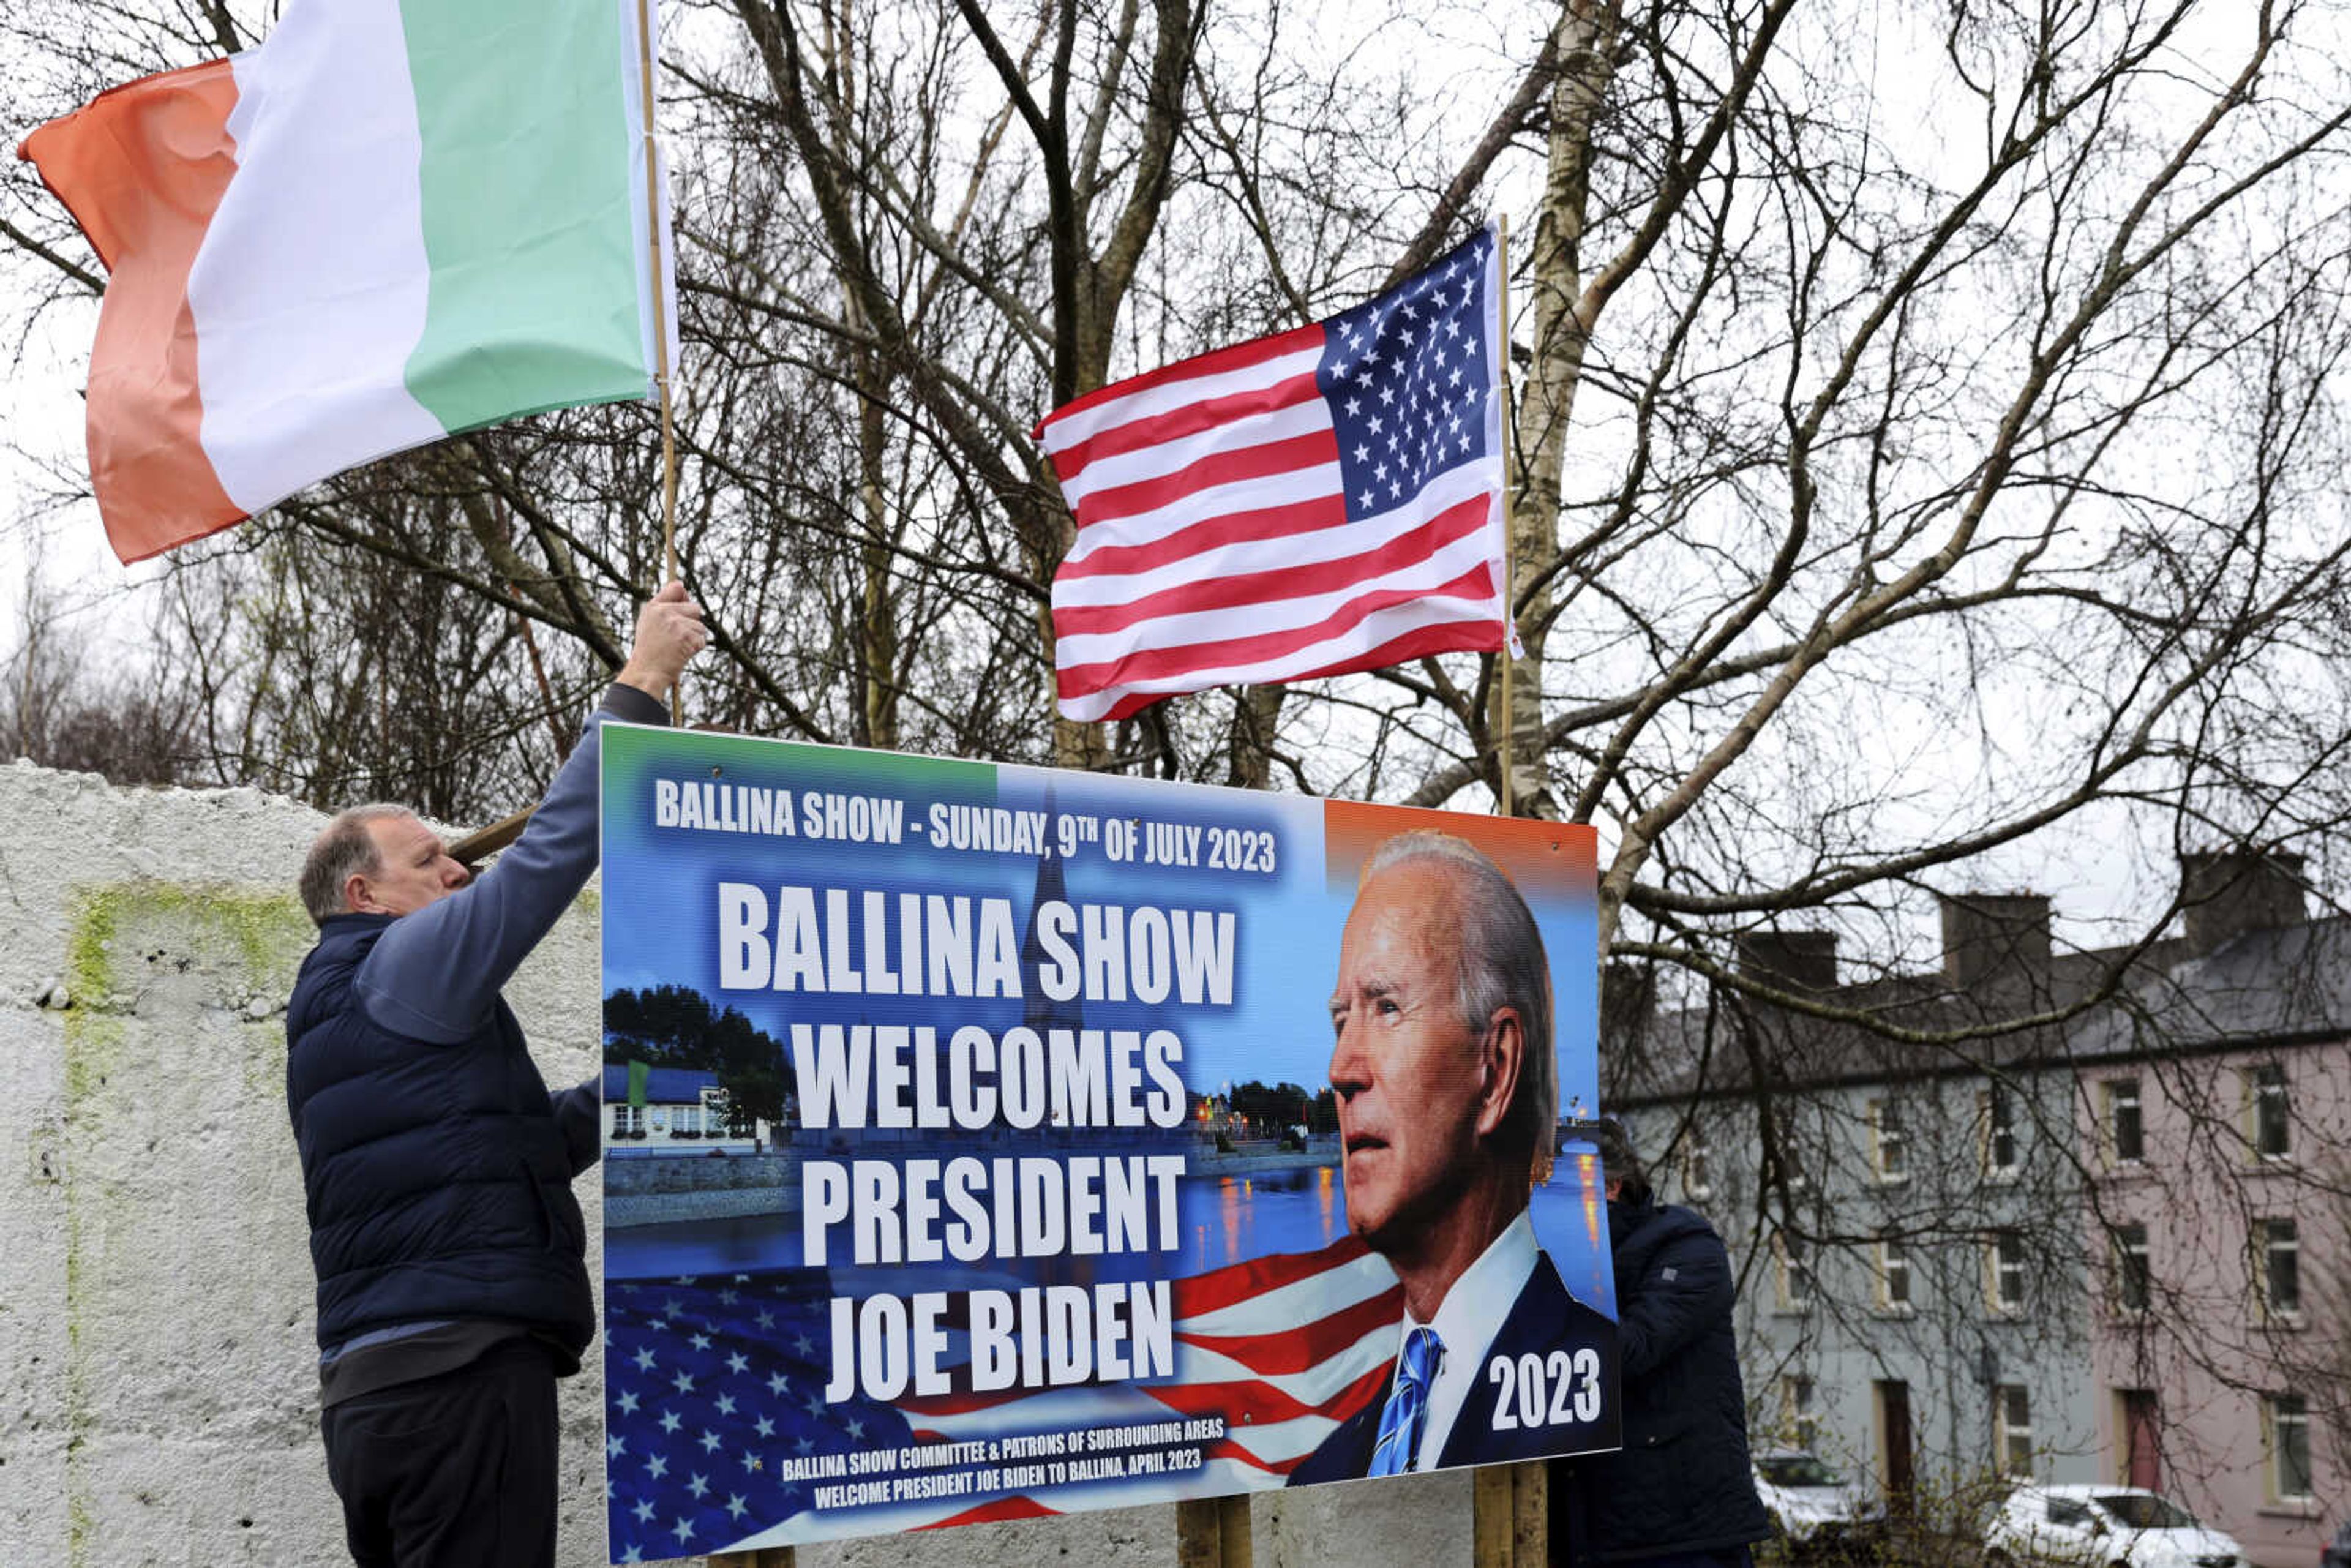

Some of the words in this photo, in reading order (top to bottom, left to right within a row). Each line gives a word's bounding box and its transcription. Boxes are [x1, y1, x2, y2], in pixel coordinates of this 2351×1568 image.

[655, 779, 795, 836] BALLINA
[803, 792, 903, 844] SHOW
[911, 822, 922, 833] -
[929, 803, 1051, 859] SUNDAY,
[1058, 814, 1098, 858] 9TH
[1105, 819, 1137, 863] OF
[1145, 823, 1201, 867] JULY
[1207, 828, 1275, 872] 2023
[718, 882, 1023, 998] BALLINA
[1037, 901, 1235, 1005] SHOW
[790, 1024, 1187, 1130] WELCOMES
[802, 1155, 1185, 1267] PRESIDENT
[825, 1292, 951, 1404] JOE
[969, 1280, 1174, 1392] BIDEN
[1489, 1348, 1601, 1431] 2023
[782, 1455, 847, 1482] BALLINA
[849, 1449, 897, 1475] SHOW
[900, 1441, 986, 1469] COMMITTEE
[989, 1443, 1000, 1460] &
[1002, 1433, 1065, 1460] PATRONS
[1068, 1432, 1085, 1452] OF
[1087, 1422, 1182, 1451] SURROUNDING
[1184, 1418, 1223, 1441] AREAS
[814, 1481, 891, 1509] WELCOME
[894, 1472, 973, 1501] PRESIDENT
[976, 1469, 1000, 1491] JOE
[1003, 1465, 1045, 1490] BIDEN
[1048, 1463, 1065, 1484] TO
[1069, 1456, 1127, 1482] BALLINA,
[1128, 1452, 1166, 1475] APRIL
[1168, 1449, 1200, 1471] 2023
